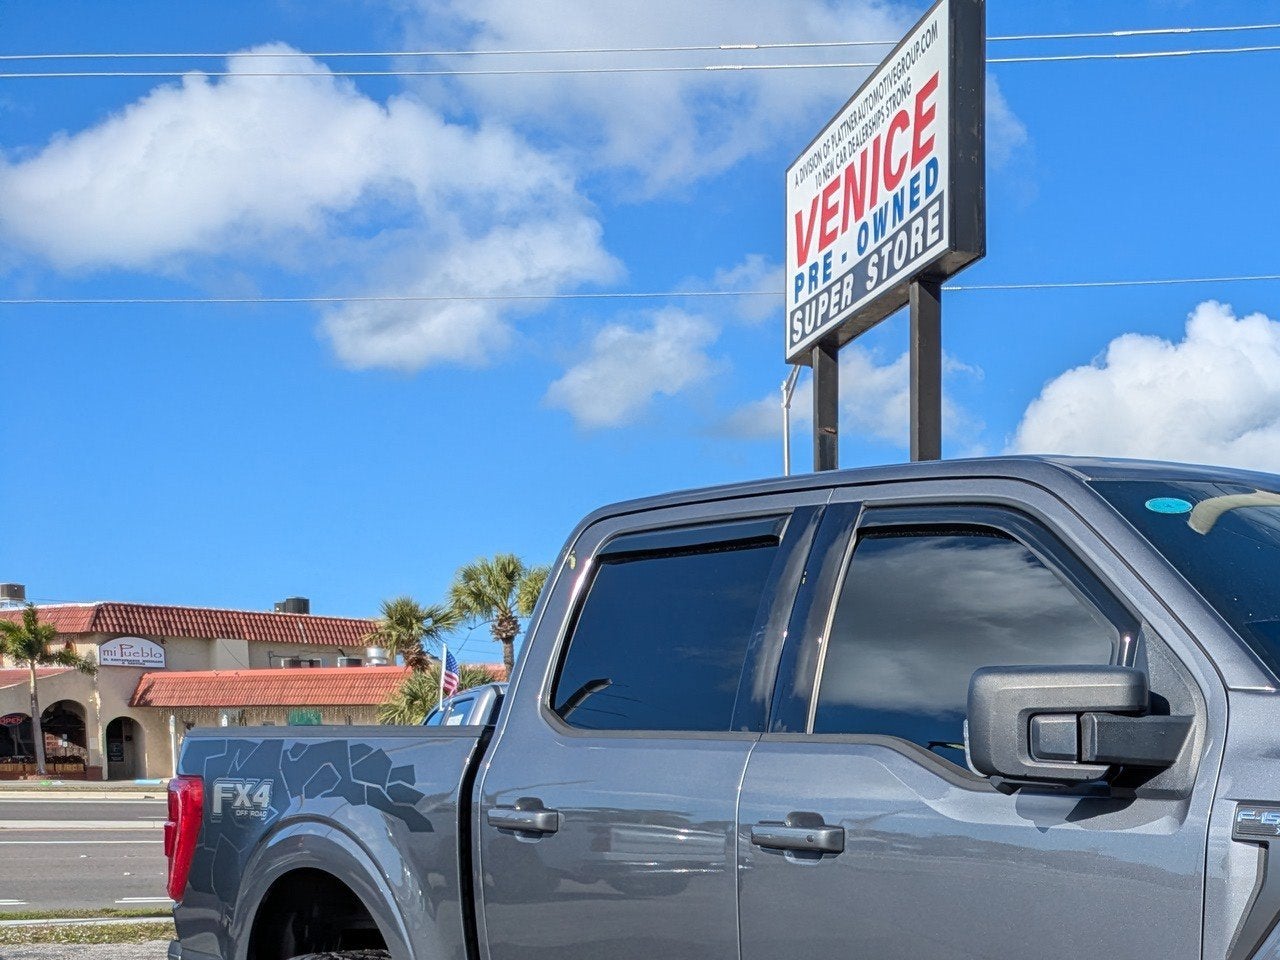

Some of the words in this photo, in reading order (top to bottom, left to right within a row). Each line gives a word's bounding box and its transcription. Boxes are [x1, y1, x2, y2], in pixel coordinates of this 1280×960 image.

[795, 173, 800, 189] A
[800, 147, 823, 184] DIVISION
[823, 138, 831, 159] OF
[831, 20, 938, 151] PLATTNERAUTOMOTIVEGROUP.COM
[815, 171, 823, 190] 10
[823, 157, 835, 180] NEW
[836, 145, 848, 169] CAR
[848, 105, 886, 158] DEALERSHIPS
[886, 76, 912, 118] STRONG
[795, 70, 939, 267] VENICE
[791, 276, 854, 344] SUPER
[865, 200, 940, 293] STORE
[103, 646, 117, 657] mi
[119, 643, 163, 659] Pueblo
[211, 780, 272, 816] FX4
[236, 809, 249, 817] OFF
[250, 810, 268, 818] ROAD
